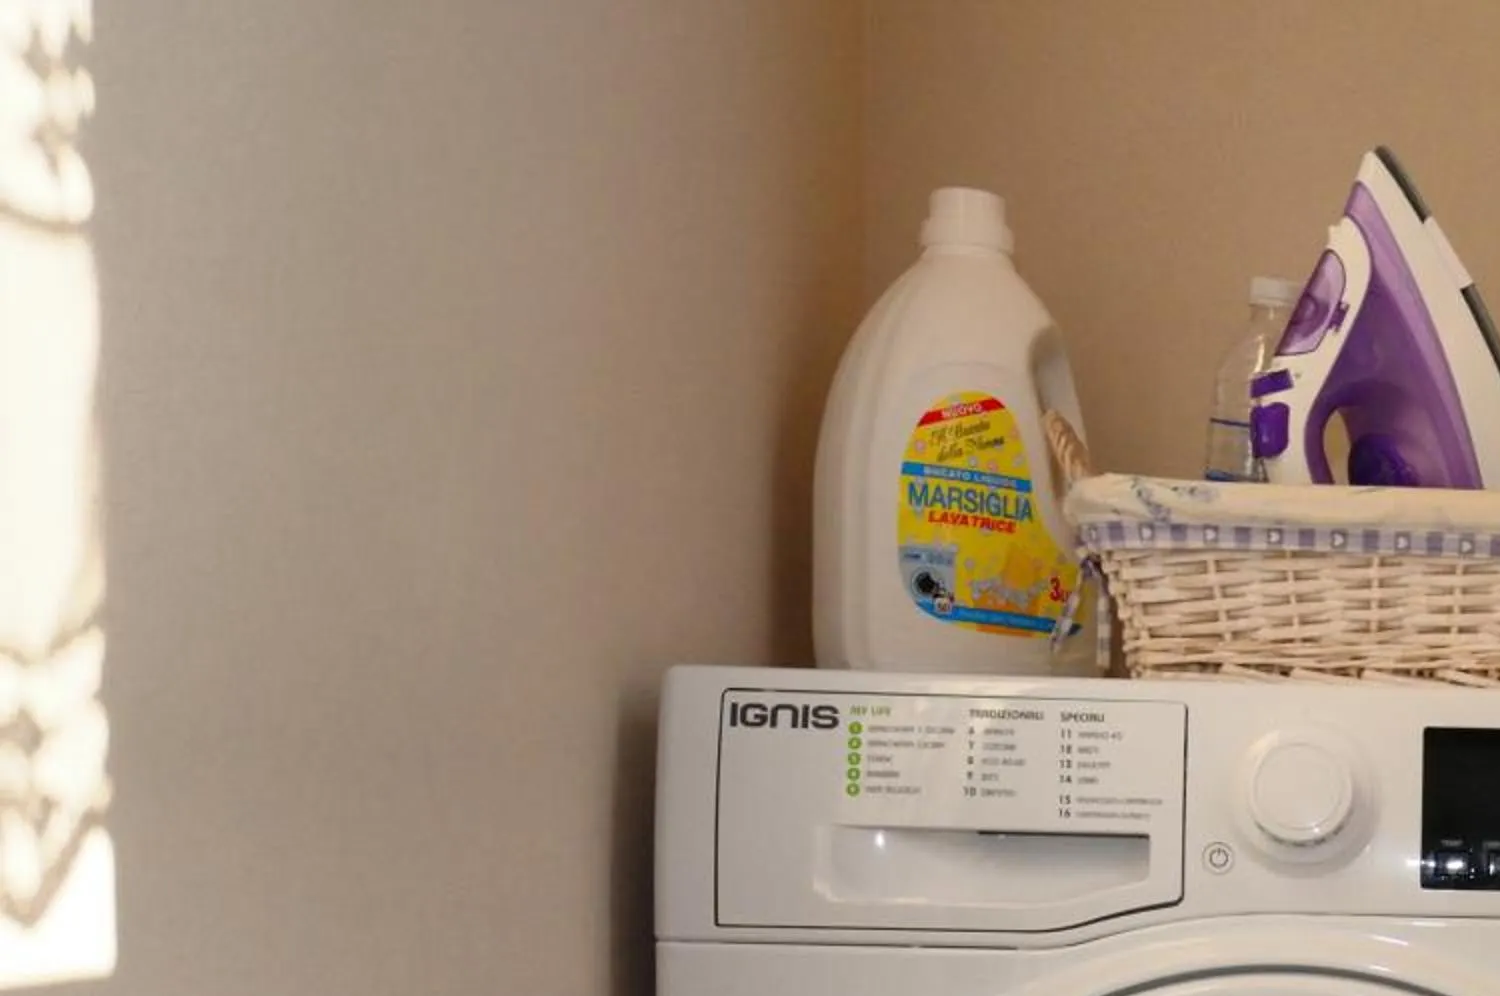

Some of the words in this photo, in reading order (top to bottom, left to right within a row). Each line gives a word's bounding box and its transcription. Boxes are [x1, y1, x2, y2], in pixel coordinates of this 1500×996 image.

[908, 481, 1034, 524] MARSIGLIA
[927, 510, 1017, 534] LAVATRICE
[729, 702, 840, 729] IGNIS
[1060, 711, 1105, 722] SPECIALI
